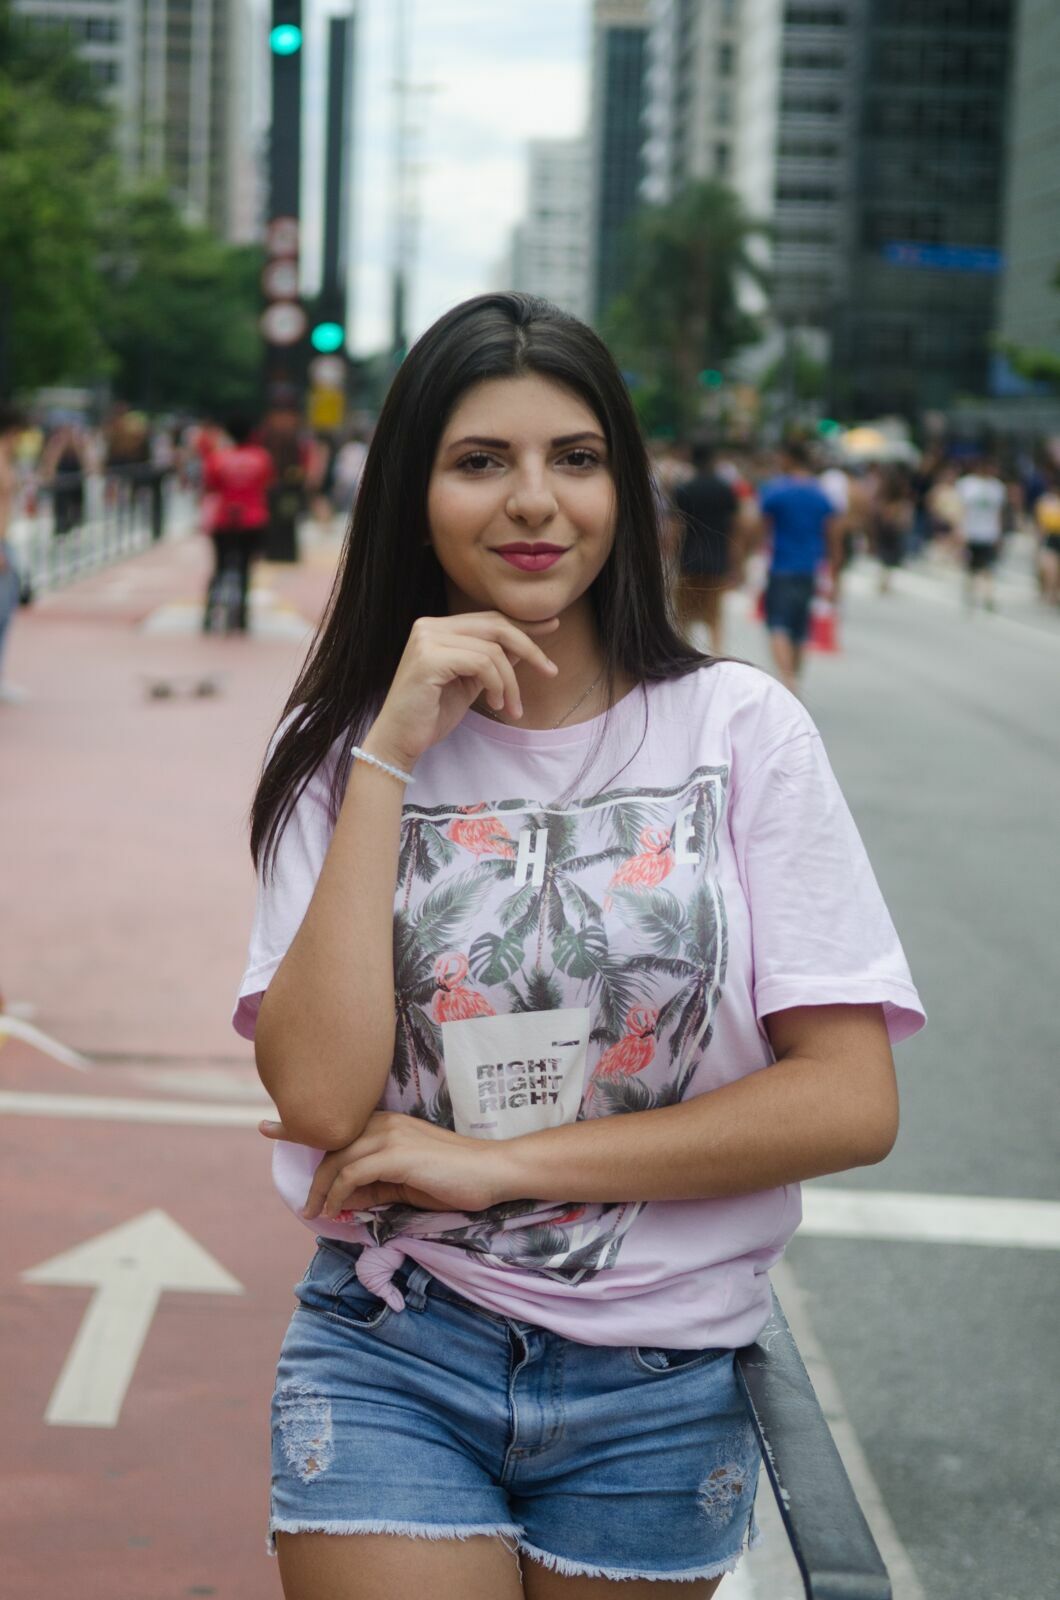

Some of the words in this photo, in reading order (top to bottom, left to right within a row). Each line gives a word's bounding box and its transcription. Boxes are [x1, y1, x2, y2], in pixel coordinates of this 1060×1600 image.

[514, 828, 549, 888] H
[675, 803, 701, 865] E
[477, 1058, 561, 1079] RIGHT
[479, 1075, 563, 1096] RIGHT
[480, 1091, 560, 1114] RIGHT
